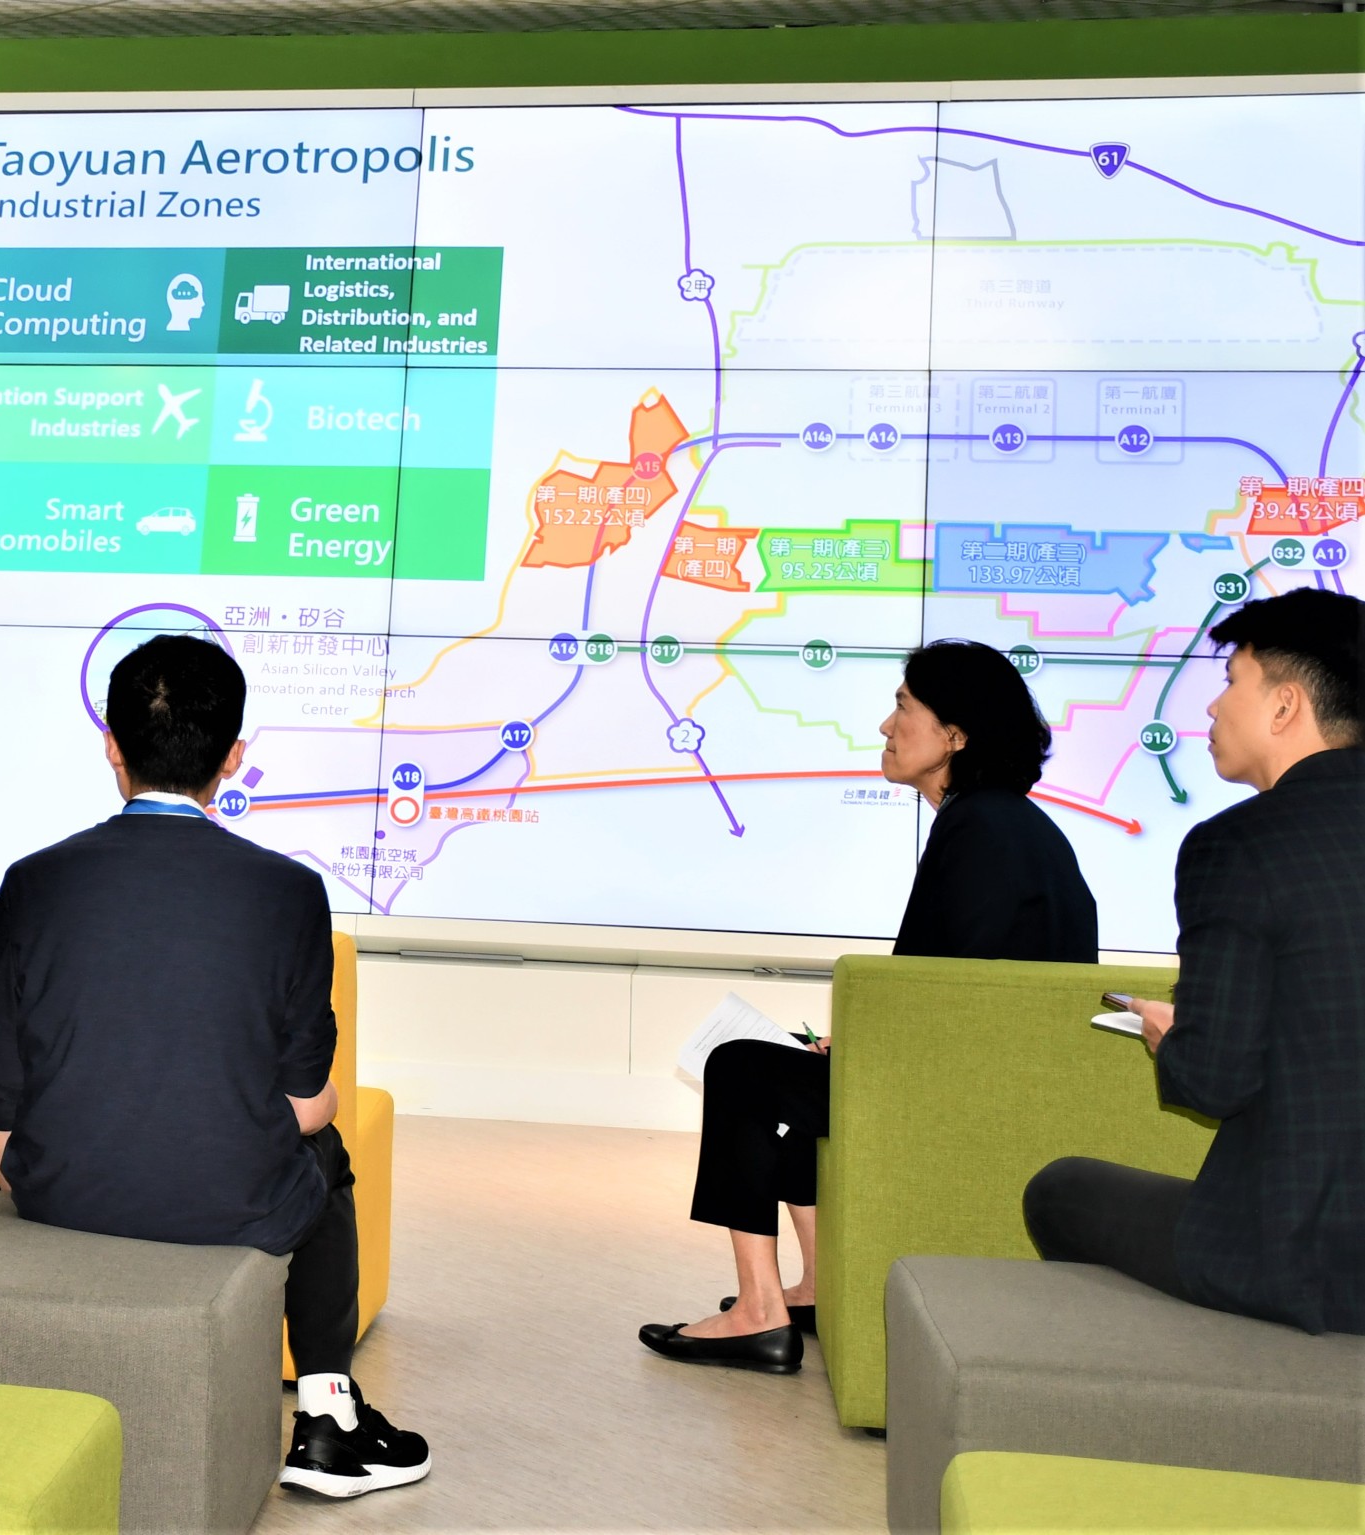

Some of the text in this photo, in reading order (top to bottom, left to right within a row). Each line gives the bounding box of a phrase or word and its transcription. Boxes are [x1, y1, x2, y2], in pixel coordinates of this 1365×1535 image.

[180, 136, 475, 184] Aerotropolis
[1097, 151, 1119, 166] 61
[156, 192, 262, 218] Zones
[305, 253, 442, 271] International
[303, 281, 395, 301] Logistics,
[1008, 298, 1065, 311] Runway
[301, 308, 478, 329] Distribution, and
[299, 335, 488, 355] Related Industries
[54, 388, 145, 410] Support
[978, 385, 1049, 399] 第二航廈
[1105, 386, 1177, 400] 第一航廈
[868, 403, 942, 413] Terminal 3
[976, 403, 1050, 414] Terminal 2
[1103, 403, 1165, 415] Terminal
[307, 406, 421, 432] Biotech
[30, 418, 141, 438] Industries
[804, 430, 833, 443] A14a
[868, 430, 896, 444] A14
[993, 431, 1022, 446] A13
[1118, 431, 1148, 447] A12
[635, 461, 660, 473] A15
[536, 484, 652, 506] 第一期(產四)
[45, 498, 124, 521] Smart
[290, 497, 380, 523] Green
[542, 507, 645, 528] 152.25公頃
[1253, 502, 1359, 522] 39.45公頃
[289, 532, 393, 566] Energy
[673, 535, 737, 557] 第一期
[769, 538, 890, 559] 第一期(產三)
[961, 540, 1088, 564] 第二期(產三)
[1272, 546, 1344, 559] G32 A11
[676, 558, 731, 579] (產四)
[781, 562, 878, 582] 95.25公頃
[968, 565, 1081, 587] 133.97公頃
[1215, 580, 1244, 594] G31
[242, 633, 389, 657] 創新研發中心
[550, 642, 613, 657] A16 G18
[651, 644, 679, 658] G17
[804, 648, 831, 662] G16
[1009, 654, 1037, 667] G15
[261, 663, 397, 680] Asian Silicon Valley
[245, 684, 416, 698] nnovation and Research
[301, 703, 349, 716] Center
[502, 730, 529, 742] A17
[680, 730, 691, 743] 2
[1142, 730, 1171, 746] G14
[393, 770, 421, 784] A18
[218, 797, 245, 810] A19
[428, 806, 539, 823] 臺灣高鐵桃園站
[340, 845, 417, 862] 桃園航空城
[331, 862, 424, 880] 股份有限公司
